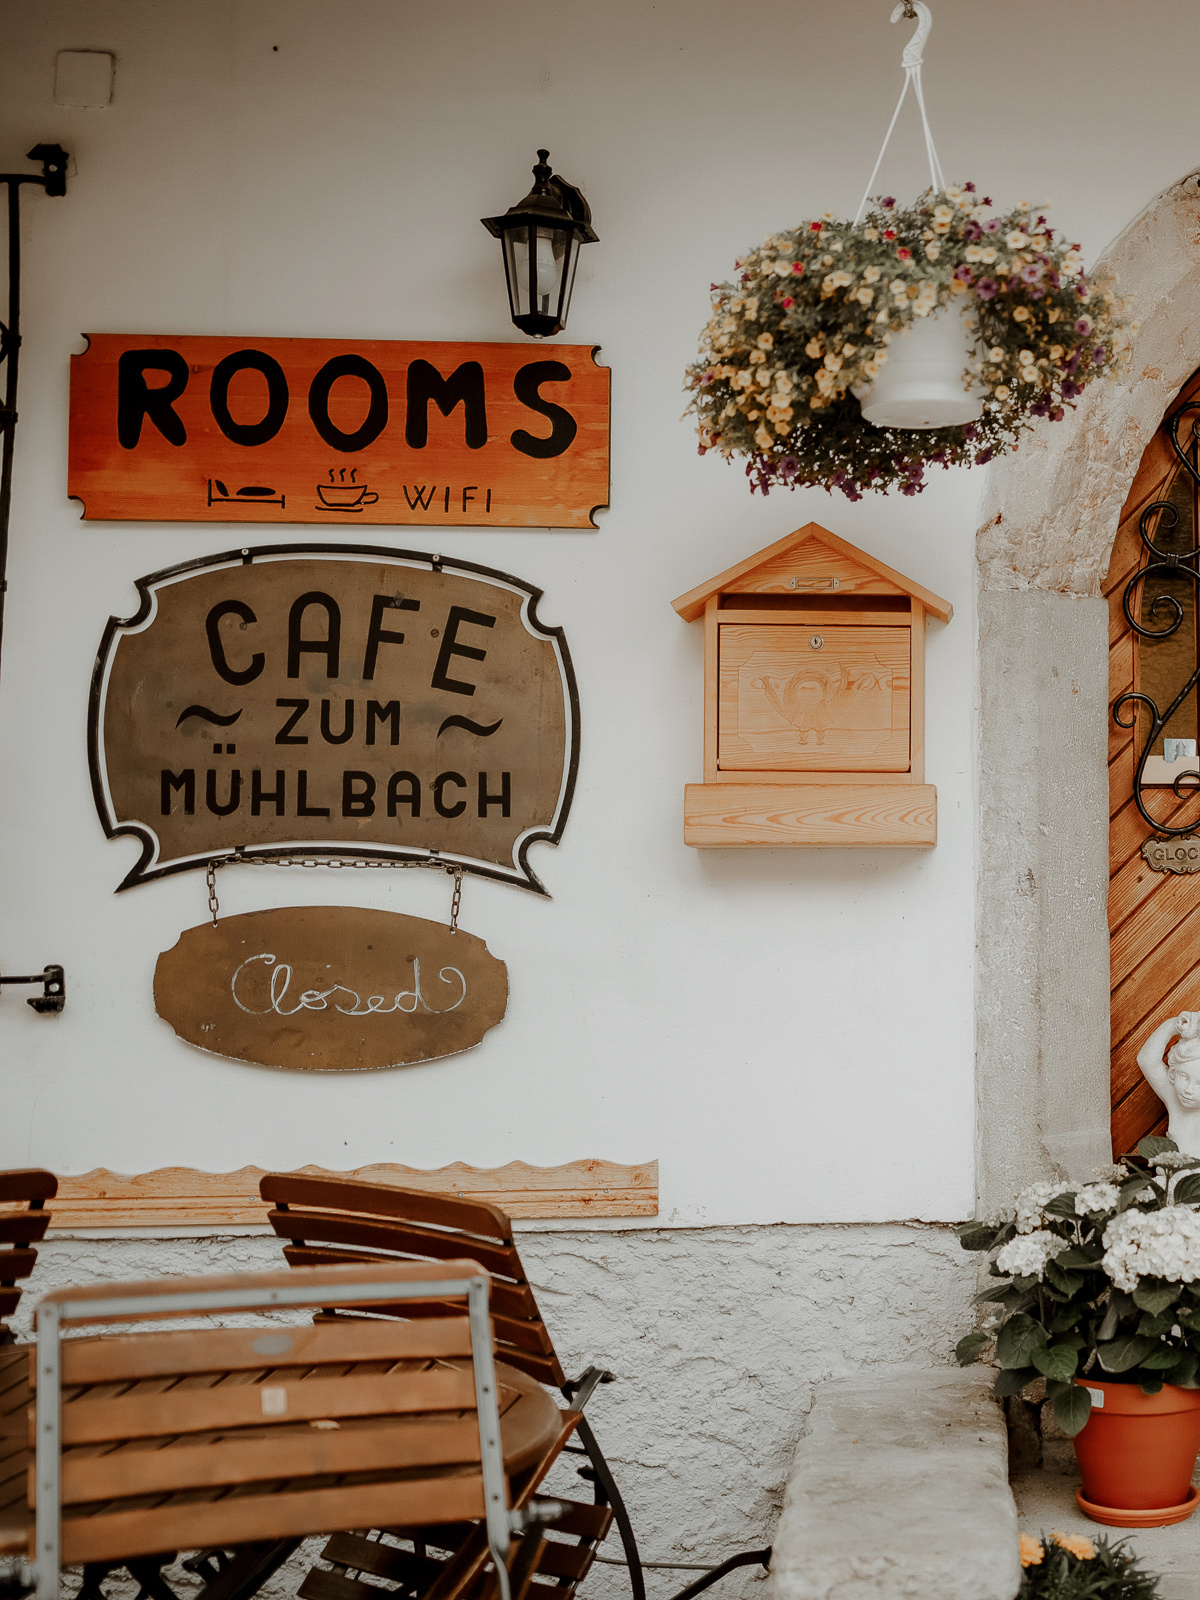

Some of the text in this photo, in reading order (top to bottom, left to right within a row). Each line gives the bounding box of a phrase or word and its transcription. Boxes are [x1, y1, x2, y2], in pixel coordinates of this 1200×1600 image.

[117, 348, 578, 460] ROOMS
[402, 485, 493, 514] WIFI
[205, 591, 497, 697] CAFE
[275, 698, 401, 746] ZUM
[160, 743, 511, 819] MÜHLBACH
[231, 953, 467, 1016] Closed
